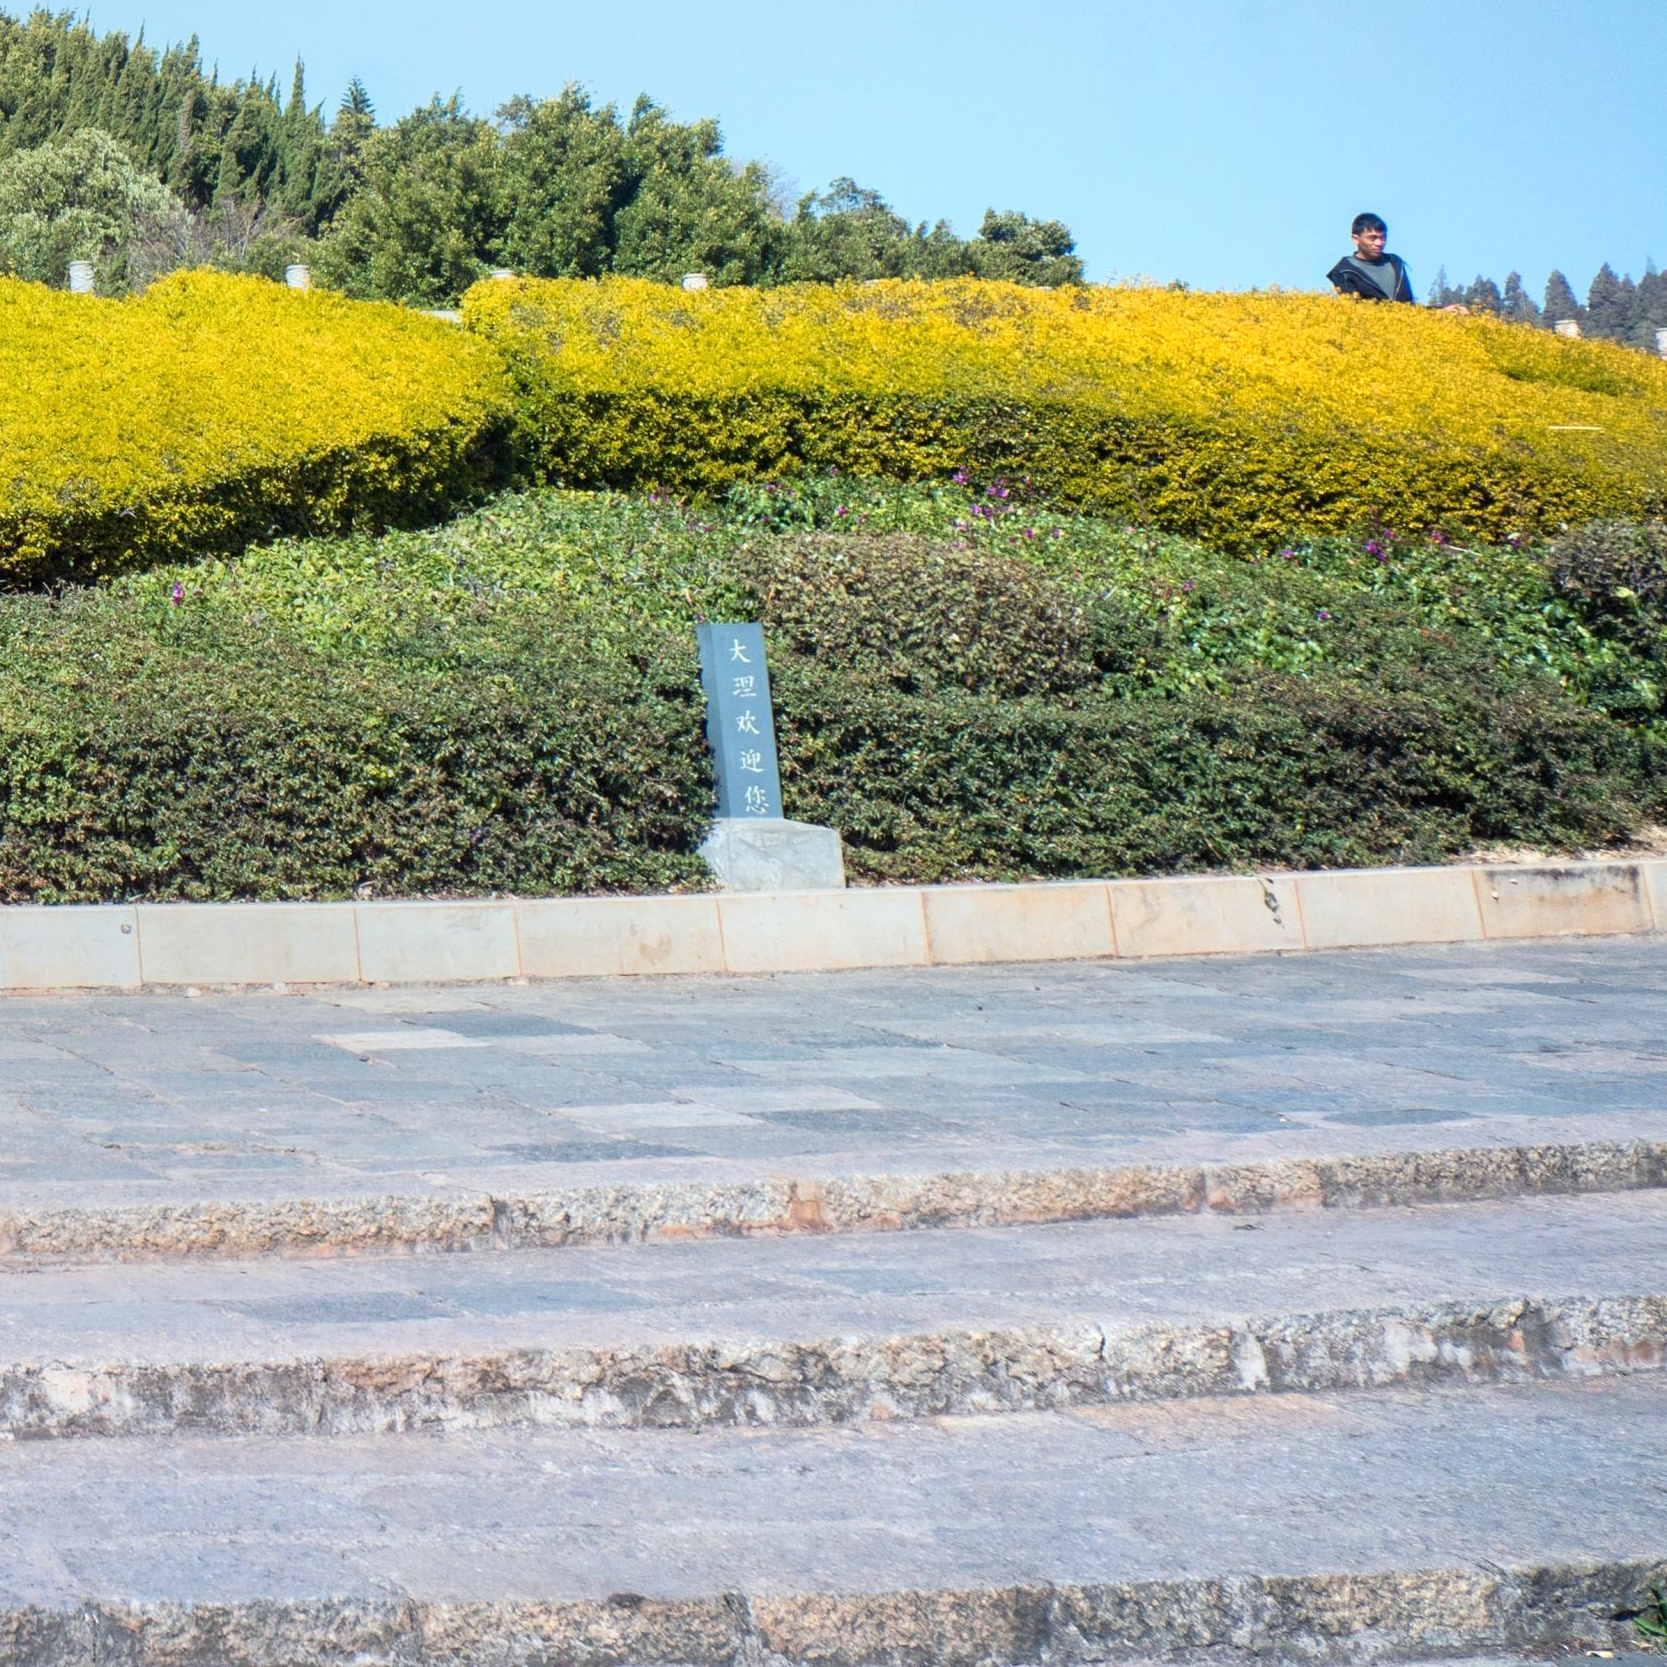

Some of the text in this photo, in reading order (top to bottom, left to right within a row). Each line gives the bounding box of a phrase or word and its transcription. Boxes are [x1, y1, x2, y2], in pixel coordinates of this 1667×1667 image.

[729, 638, 769, 814] 大理欢迎您
